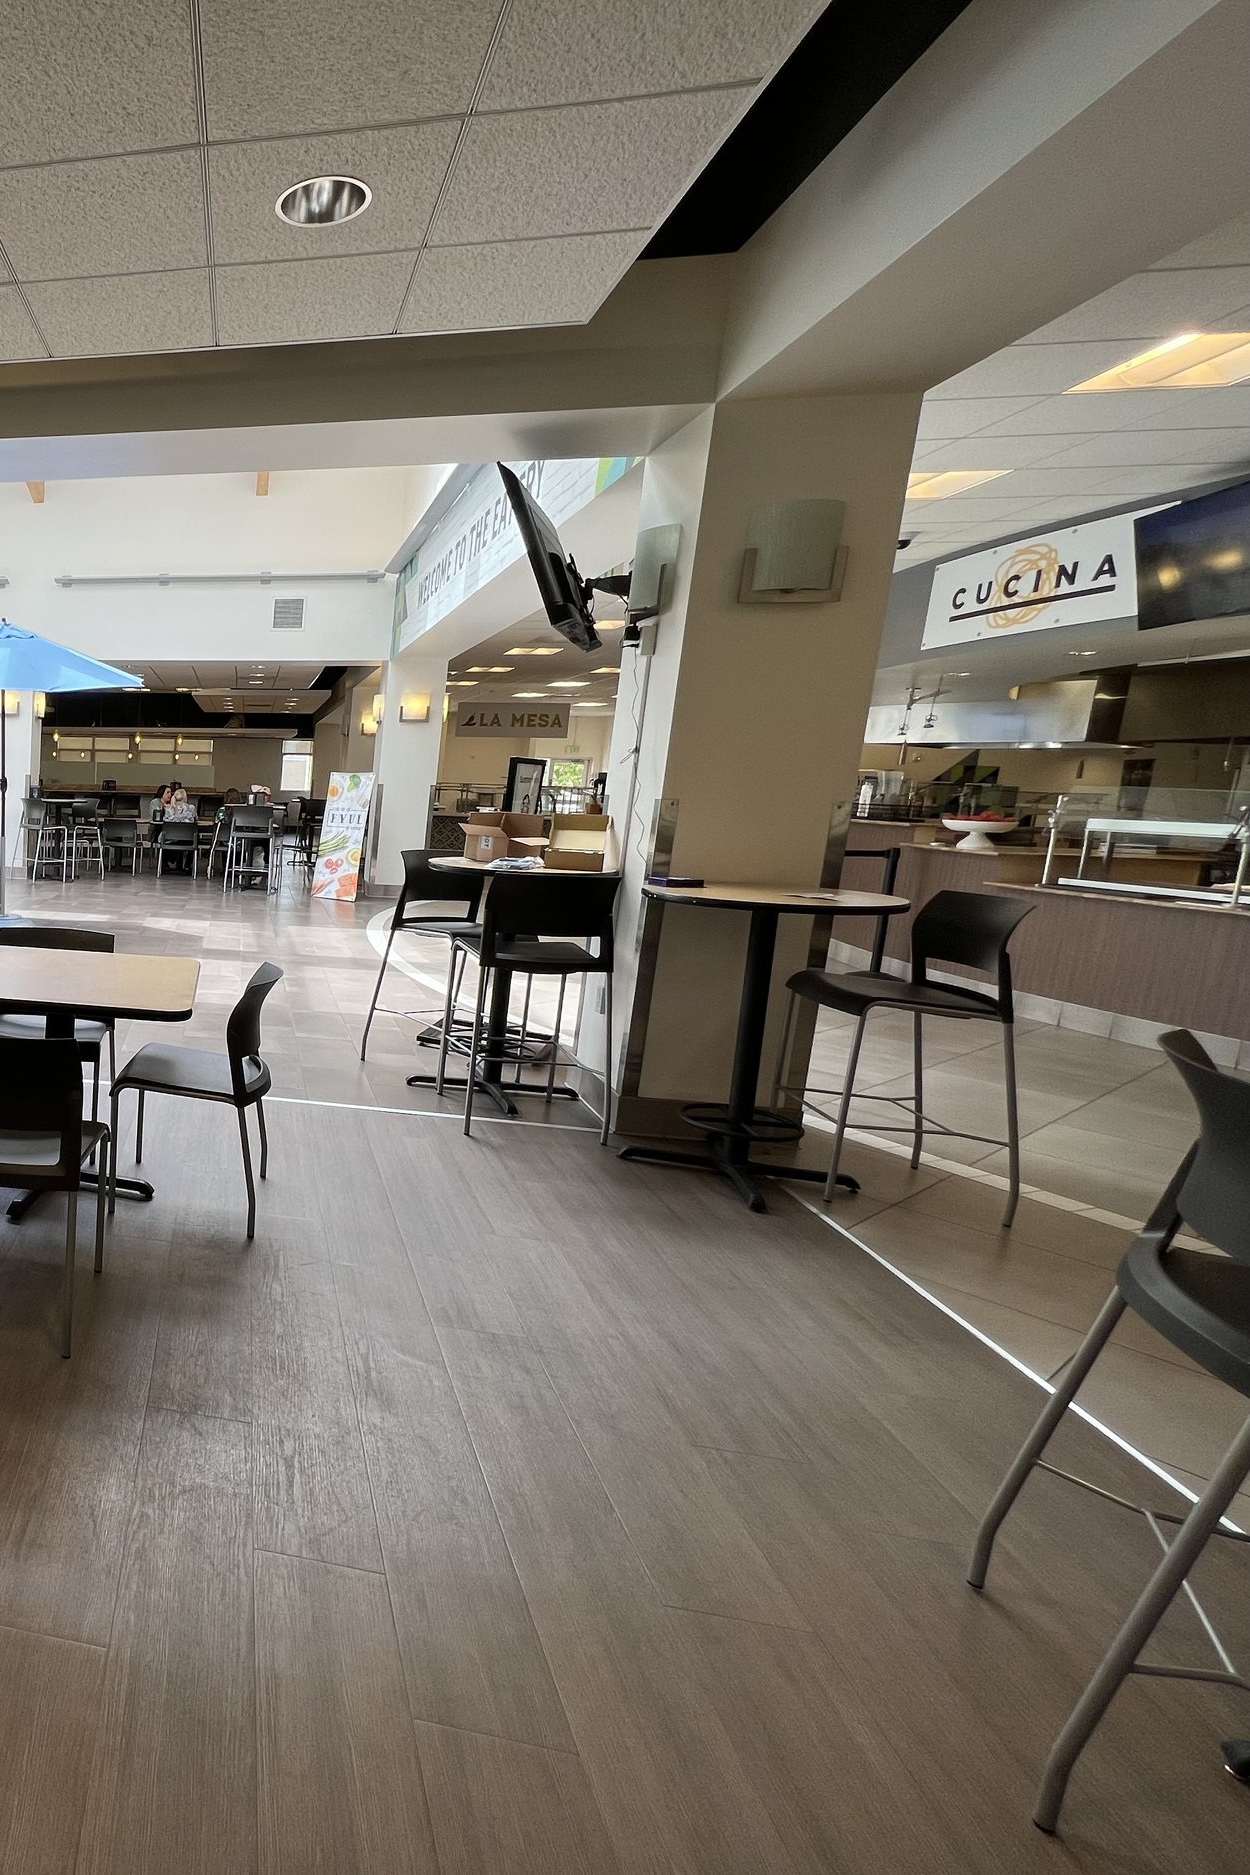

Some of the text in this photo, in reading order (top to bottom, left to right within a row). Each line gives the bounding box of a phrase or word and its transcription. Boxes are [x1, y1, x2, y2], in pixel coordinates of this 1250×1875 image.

[418, 460, 545, 609] WELCOME TO THE EARY
[952, 554, 1117, 609] CUCINA
[479, 713, 562, 728] LA MESA
[330, 813, 363, 825] FYUL
